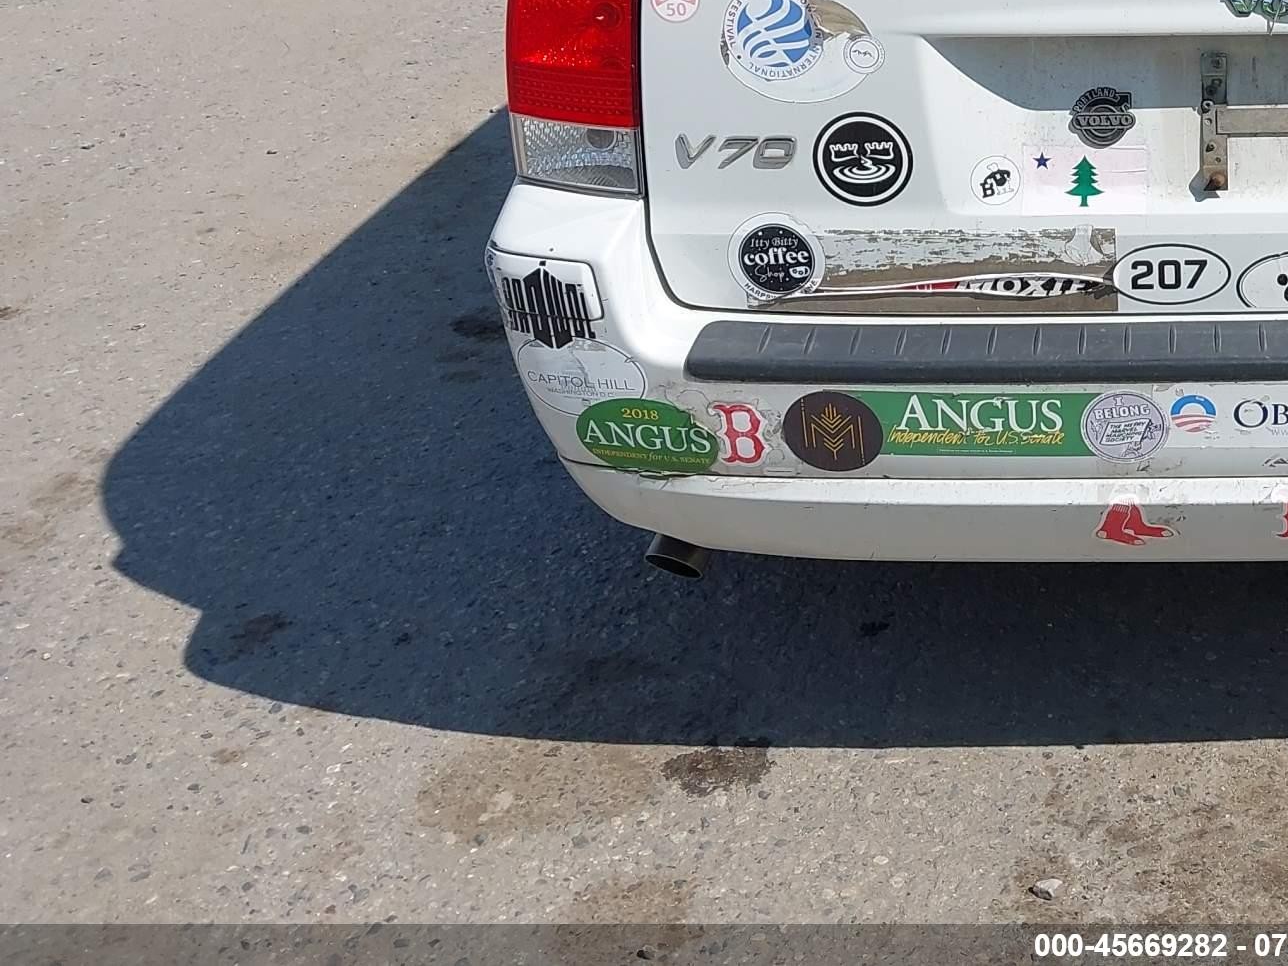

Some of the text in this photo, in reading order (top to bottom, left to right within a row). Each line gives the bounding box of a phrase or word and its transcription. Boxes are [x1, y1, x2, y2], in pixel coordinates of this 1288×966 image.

[666, 2, 687, 16] 50
[1072, 87, 1117, 113] PORTLAND
[1077, 115, 1133, 126] VOLVO
[674, 133, 798, 170] V70
[750, 236, 799, 250] Itty Bitty
[743, 247, 809, 266] coffee
[754, 264, 786, 283] Shop
[1130, 259, 1209, 290] 207
[526, 370, 595, 389] CAPITOL
[597, 377, 637, 391] HILL
[1113, 395, 1124, 407] I
[621, 407, 660, 421] 2018
[896, 393, 1064, 433] ANGUS
[1093, 403, 1151, 420] BELONG
[583, 419, 712, 455] ANGUS
[712, 404, 766, 464] B
[974, 429, 990, 446] for
[1021, 431, 1065, 446] Senate
[649, 451, 663, 462] for
